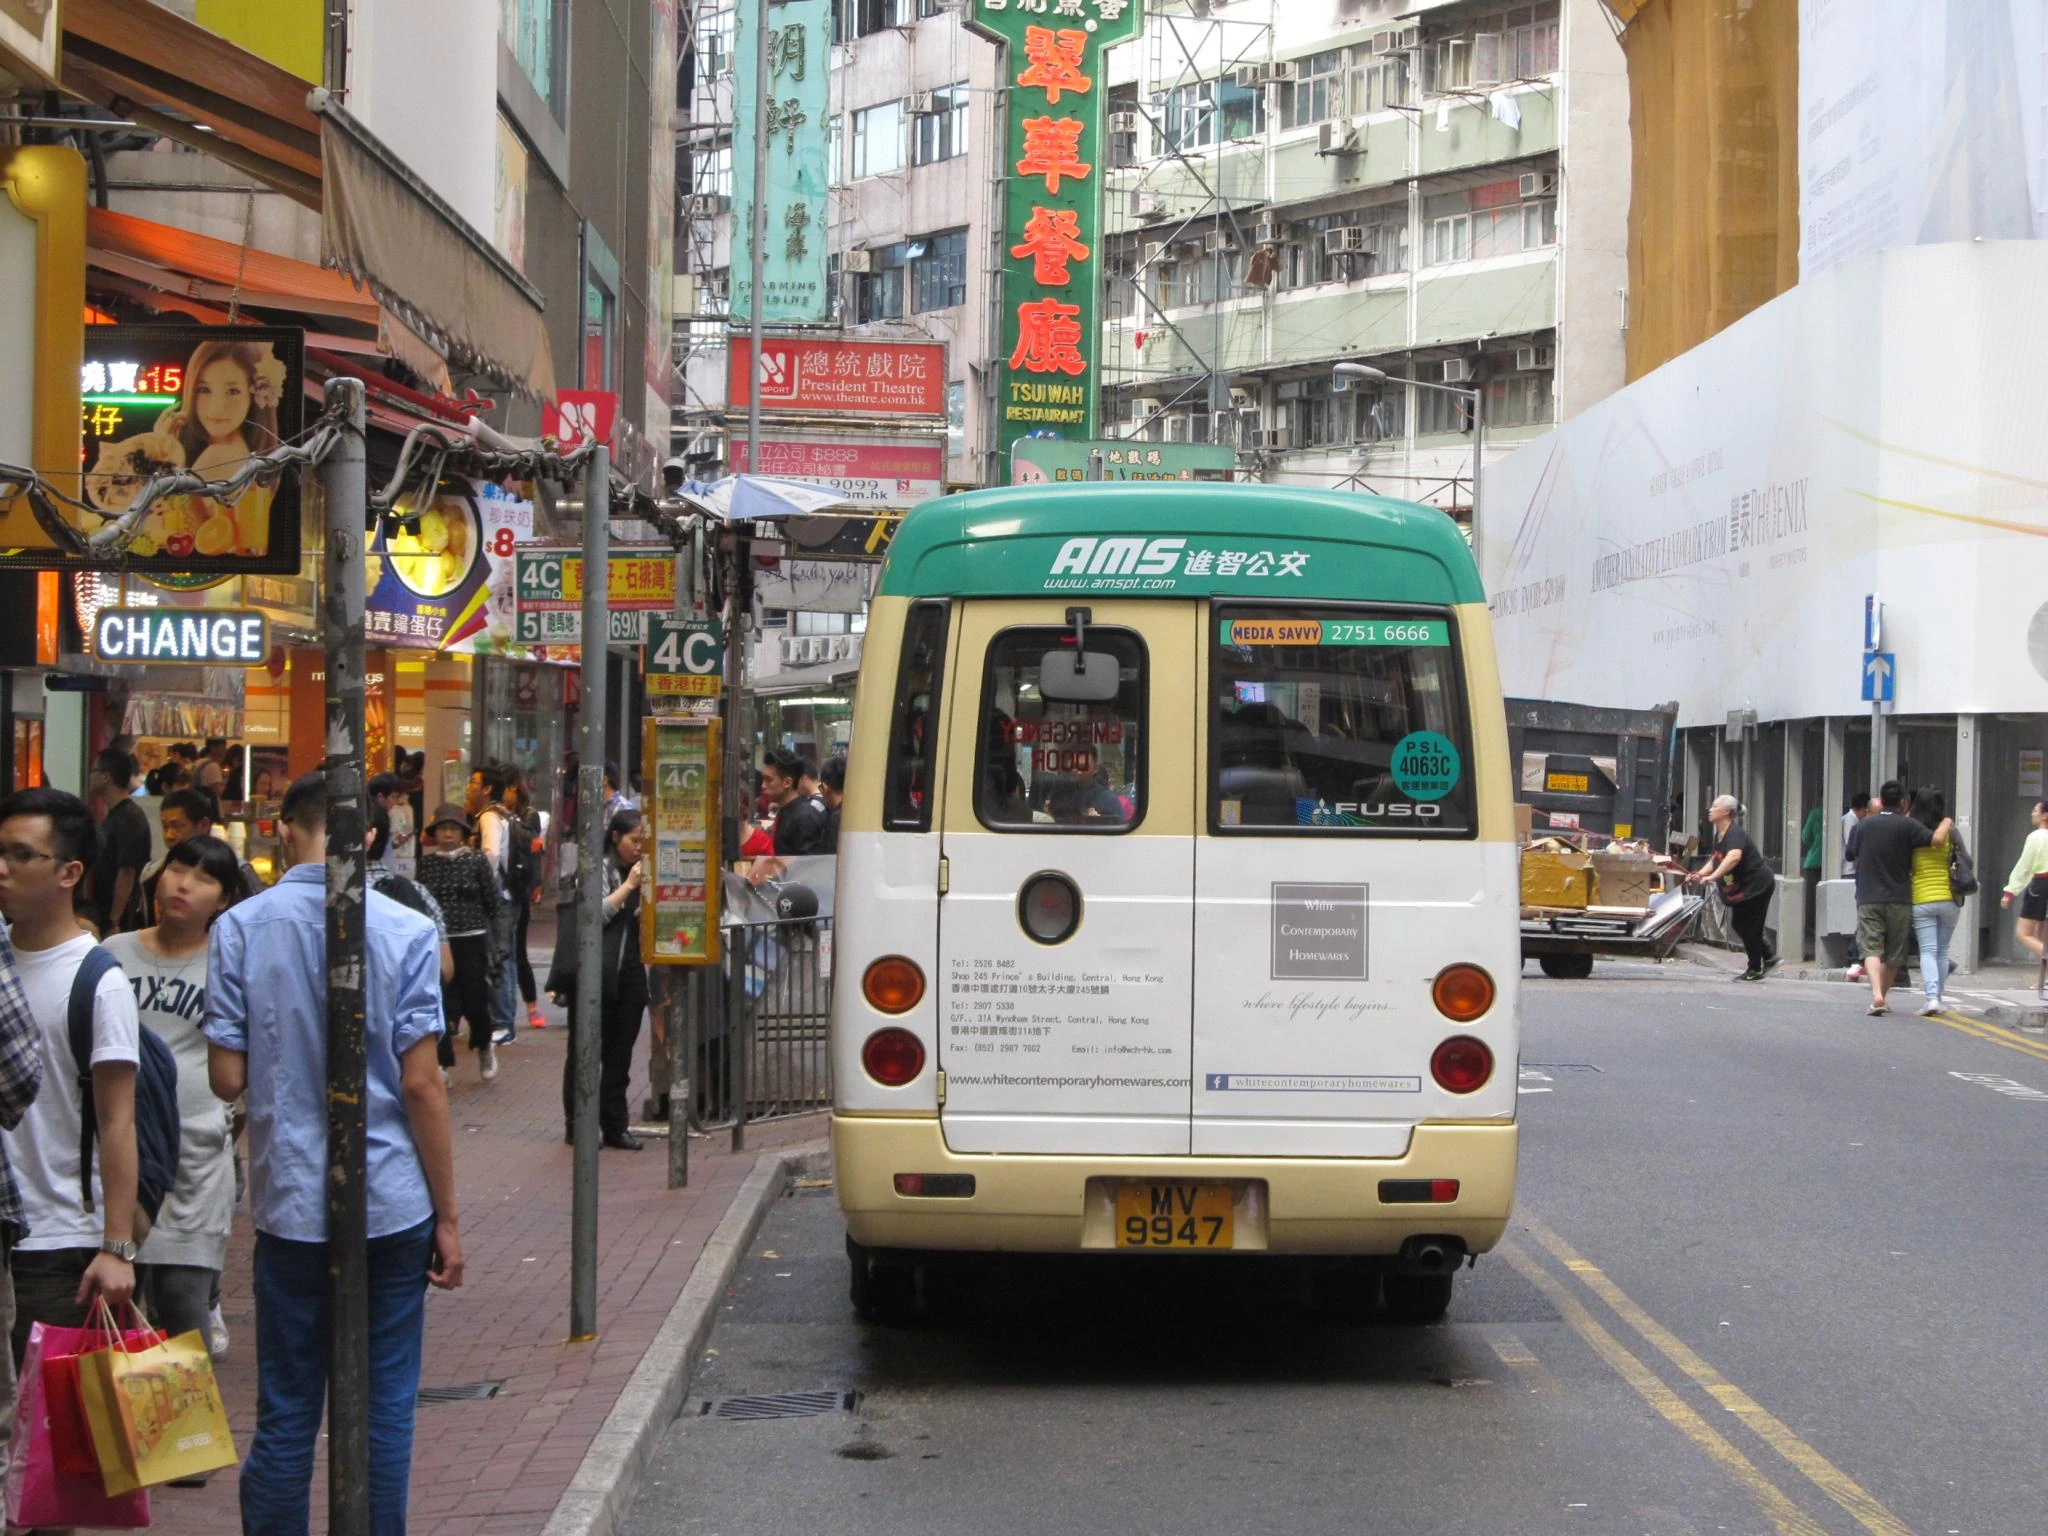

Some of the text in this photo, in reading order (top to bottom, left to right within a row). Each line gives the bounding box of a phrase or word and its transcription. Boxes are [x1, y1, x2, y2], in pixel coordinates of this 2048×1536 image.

[1008, 25, 1093, 376] 翠華餐廳
[743, 295, 810, 305] CISINE
[802, 350, 927, 378] 總統戲院
[802, 379, 925, 394] President Theatre
[1011, 382, 1083, 404] TSUI WAH
[801, 394, 926, 405] www.theatre.com.hk
[1006, 406, 1084, 423] RESTAURANT
[811, 448, 858, 462] $888
[485, 528, 514, 557] $8
[1049, 538, 1311, 577] AMS 進智公交
[522, 561, 561, 588] 4C
[1043, 577, 1176, 590] www.amspt.com
[523, 612, 538, 639] 5
[611, 612, 640, 639] 69X
[1233, 626, 1430, 641] MEDIA SAVVY 2751 6666
[100, 616, 261, 658] CHANGE
[653, 632, 716, 674] 4C
[657, 676, 706, 692] 香港仔
[1406, 741, 1443, 753] PSL
[1400, 755, 1450, 777] 4063C
[664, 769, 700, 790] 4C
[1335, 803, 1440, 817] FUSO
[952, 960, 969, 968] Tel:
[951, 972, 970, 981] Shop
[974, 972, 988, 980] 245
[1122, 975, 1141, 983] Hong
[1144, 975, 1164, 984] Kong
[950, 1001, 969, 1010] Tel:
[1108, 1017, 1127, 1025] Hong
[1130, 1017, 1150, 1026] Kong
[950, 1044, 969, 1053] Fax:
[1072, 1046, 1099, 1054] Email:
[950, 1073, 1193, 1089] www.whitecontemporaryhomewares.com
[1236, 1077, 1412, 1090] whitecontemporaryhomewares
[1150, 1187, 1198, 1216] MV
[1126, 1216, 1224, 1246] 9947
